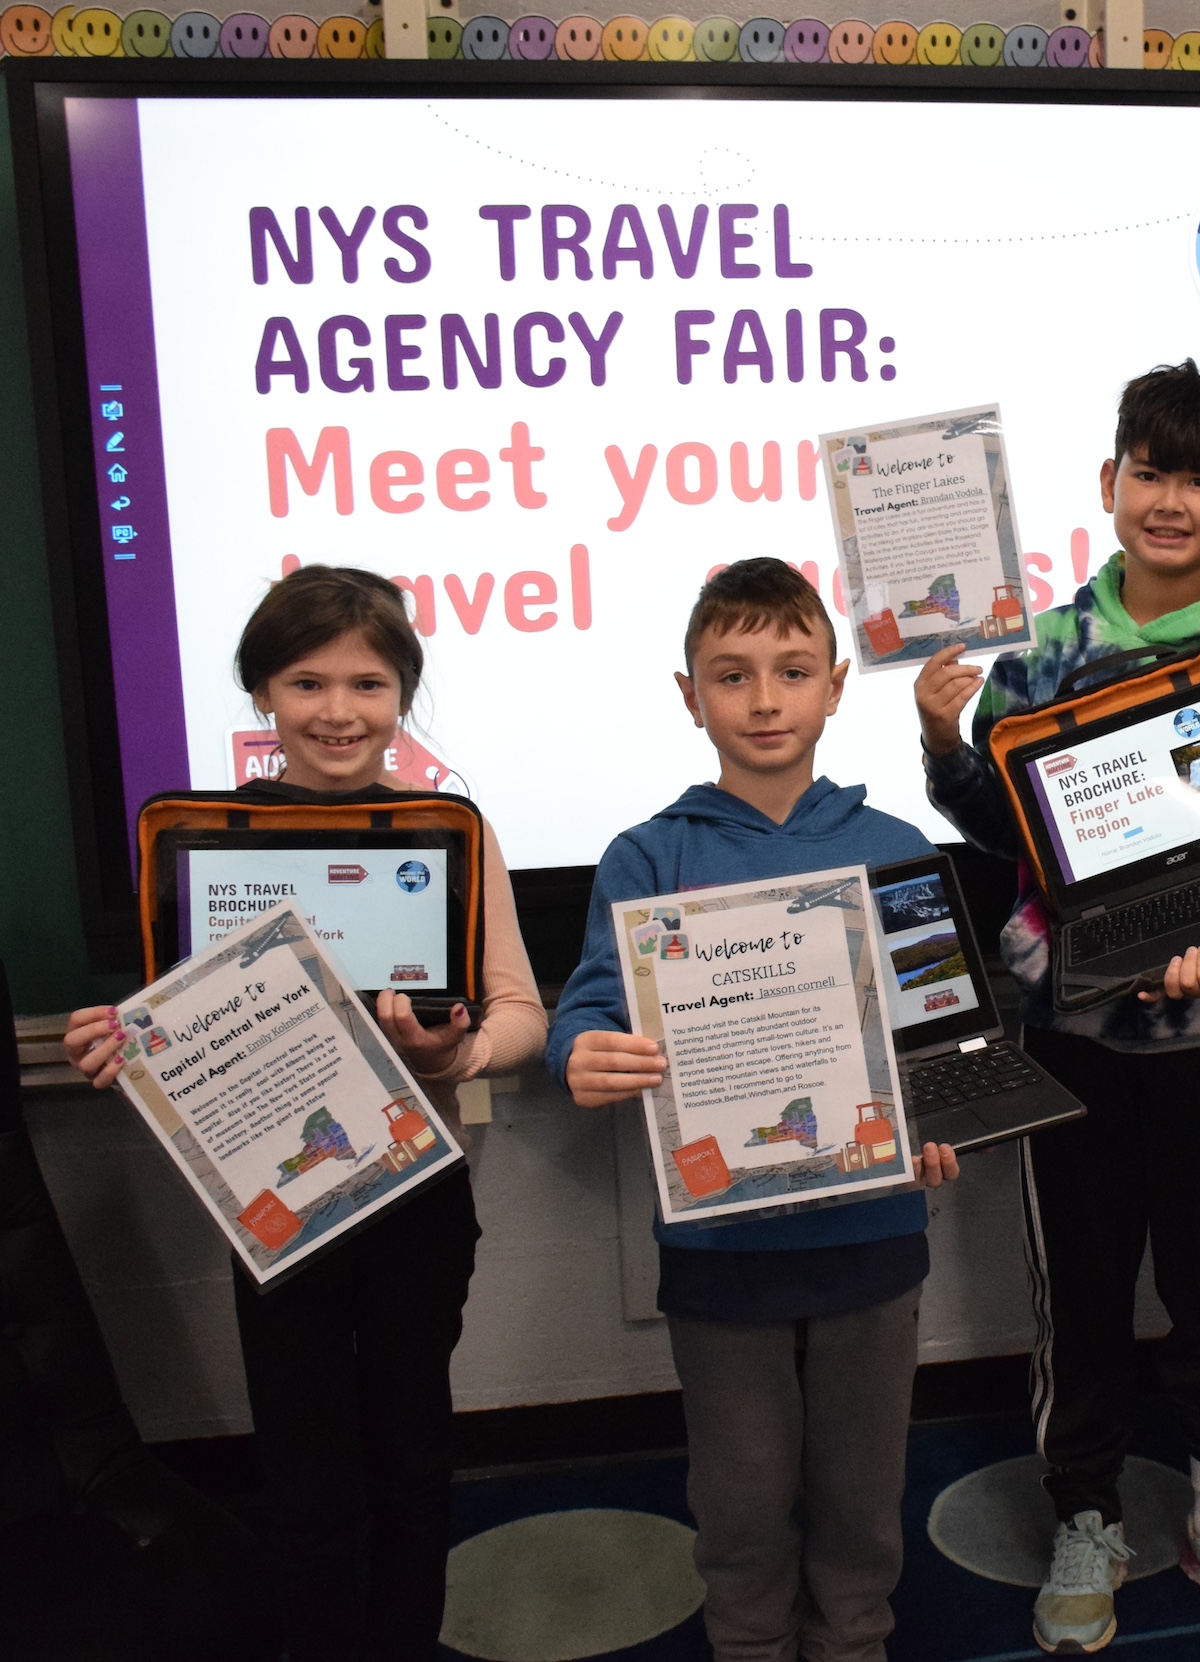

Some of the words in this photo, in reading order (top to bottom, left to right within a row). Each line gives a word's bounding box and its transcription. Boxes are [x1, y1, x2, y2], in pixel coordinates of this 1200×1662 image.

[249, 206, 433, 285] NYS
[478, 203, 813, 281] TRAVEL
[255, 311, 624, 394] AGENCY
[673, 308, 897, 386] FAIR:
[265, 421, 548, 518] Meet
[876, 457, 933, 477] Welcome
[936, 453, 955, 468] to
[871, 486, 893, 499] The
[894, 480, 931, 495] Finger
[932, 474, 966, 488] Lakes
[853, 502, 885, 516] Travel
[886, 499, 919, 512] Agent:
[1177, 723, 1200, 735] WORLD
[1058, 770, 1088, 791] NYS
[1092, 750, 1147, 778] TRAVEL
[1063, 770, 1146, 807] BROCHURE:
[1069, 799, 1119, 825] Finger
[1126, 785, 1164, 805] Lake
[1075, 816, 1130, 843] Region
[1166, 850, 1188, 866] acer
[208, 884, 237, 896] NYS
[243, 883, 297, 896] TRAVEL
[399, 875, 426, 883] WORLD
[695, 936, 775, 962] Welcome
[779, 931, 806, 950] to
[711, 961, 796, 986] CATSKILLS
[758, 984, 796, 998] Jaxson
[797, 975, 836, 991] cornell
[172, 995, 242, 1043] Welcome
[244, 981, 267, 1002] to
[661, 996, 706, 1014] Travel
[709, 991, 754, 1008] Agent:
[160, 1046, 206, 1082] Capital/
[209, 1018, 253, 1051] Central
[254, 1002, 281, 1023] New
[281, 984, 310, 1004] York
[673, 1036, 704, 1046] stunning
[704, 1030, 730, 1041] natural
[730, 1027, 755, 1037] beauty
[756, 1020, 789, 1032] abundant
[790, 1017, 817, 1027] outdoor
[686, 1023, 711, 1033] should
[711, 1020, 726, 1029] visit
[740, 1013, 766, 1024] Catskill
[767, 1009, 800, 1019] Mountain
[244, 1032, 272, 1053] Emily
[722, 1038, 755, 1049] charming
[756, 1032, 794, 1043] small-town
[822, 1024, 833, 1032] It's
[676, 1057, 694, 1067] ideal
[695, 1052, 734, 1064] destination
[746, 1046, 769, 1055] nature
[794, 1039, 817, 1047] hikers
[817, 1035, 831, 1044] and
[678, 1068, 705, 1078] anyone
[706, 1063, 734, 1074] seeking
[774, 1052, 803, 1062] Offering
[804, 1046, 834, 1057] anything
[835, 1043, 852, 1051] from
[167, 1072, 208, 1102] Travel
[208, 1051, 247, 1079] Agent:
[680, 1076, 724, 1088] breathtaking
[724, 1070, 758, 1081] mountain
[758, 1066, 779, 1075] views
[780, 1063, 794, 1072] and
[794, 1057, 829, 1069] waterfalls
[681, 1089, 708, 1098] historic
[732, 1077, 775, 1090] recommend
[784, 1075, 794, 1083] go
[681, 1147, 715, 1166] PASSPORT
[248, 1197, 277, 1228] PASSPORT
